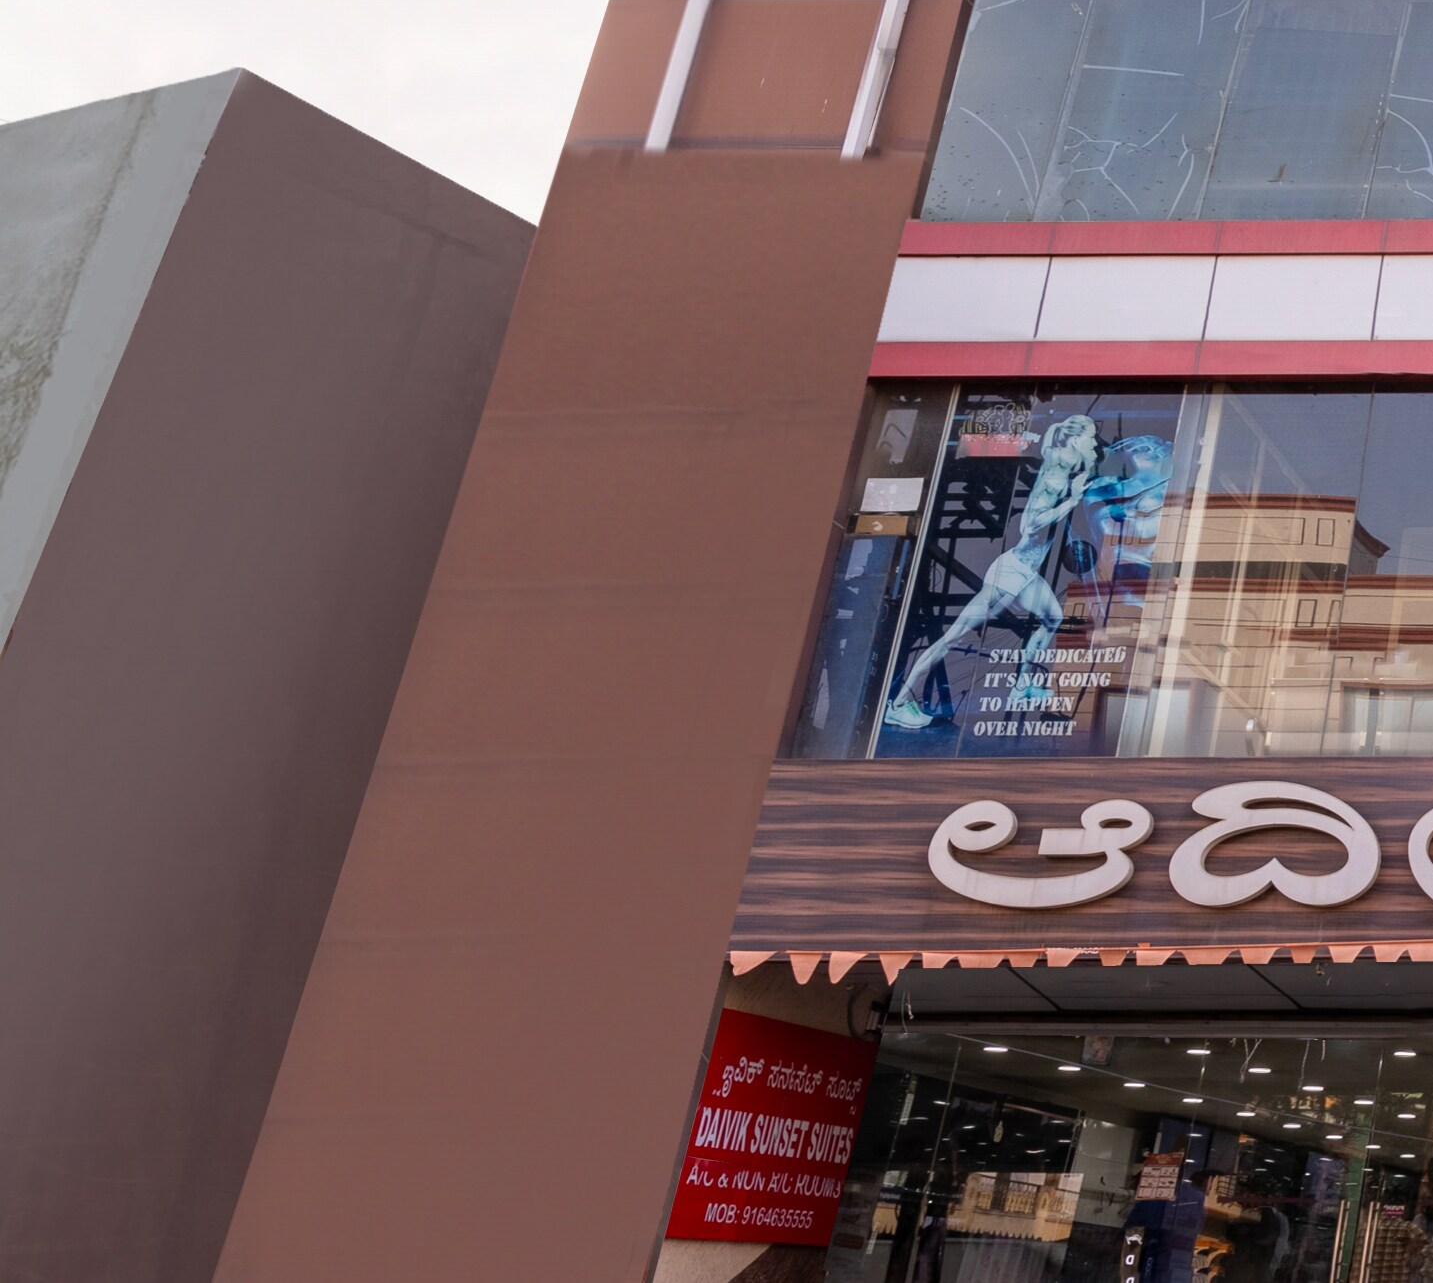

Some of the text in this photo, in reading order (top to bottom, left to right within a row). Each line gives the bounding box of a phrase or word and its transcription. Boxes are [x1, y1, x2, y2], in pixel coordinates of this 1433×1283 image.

[989, 648, 1030, 664] STAY
[983, 672, 1111, 688] IT'S NOT GOING
[980, 696, 1075, 712] TO HAPPEN
[974, 721, 1077, 736] OVER NIGHT
[695, 1106, 854, 1165] DAIVIK SUNSET SUITES
[704, 1203, 814, 1229] MOB: 9164635555
